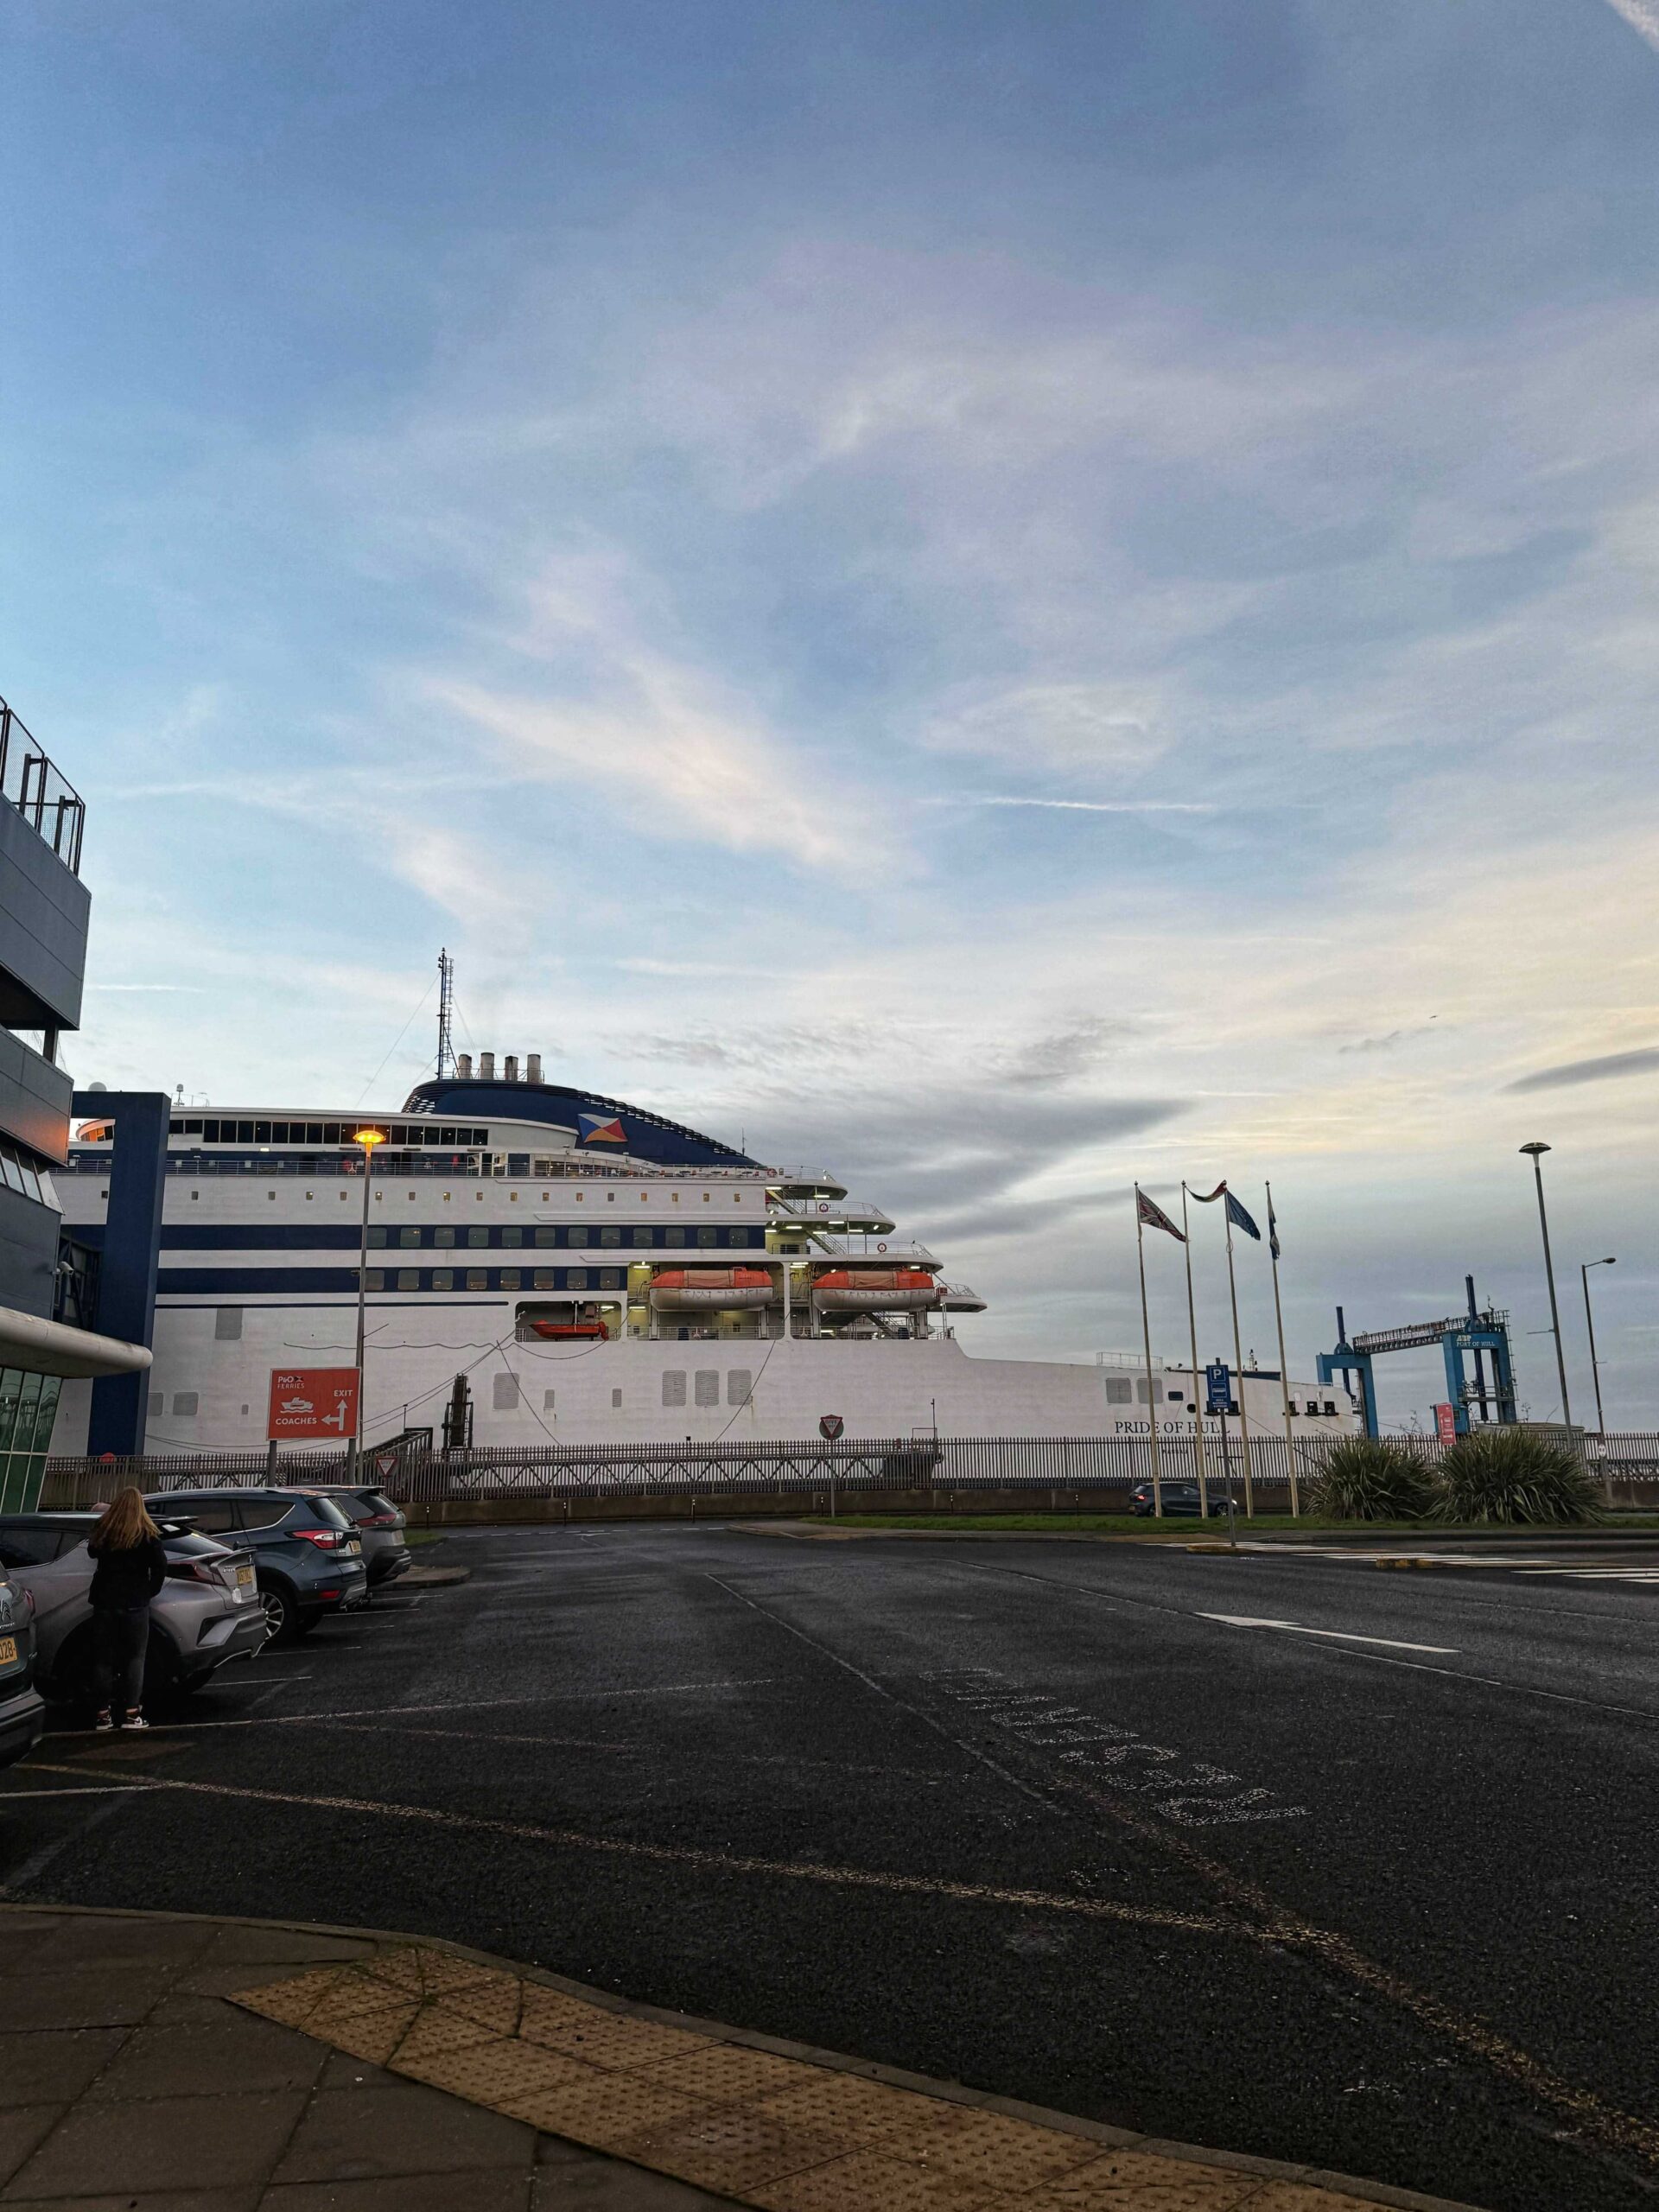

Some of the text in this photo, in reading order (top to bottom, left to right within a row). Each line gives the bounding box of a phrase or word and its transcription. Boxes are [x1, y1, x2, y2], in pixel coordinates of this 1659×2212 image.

[1213, 1369, 1222, 1379] P
[1115, 1421, 1160, 1433] PRIDE
[1163, 1421, 1184, 1433] OF
